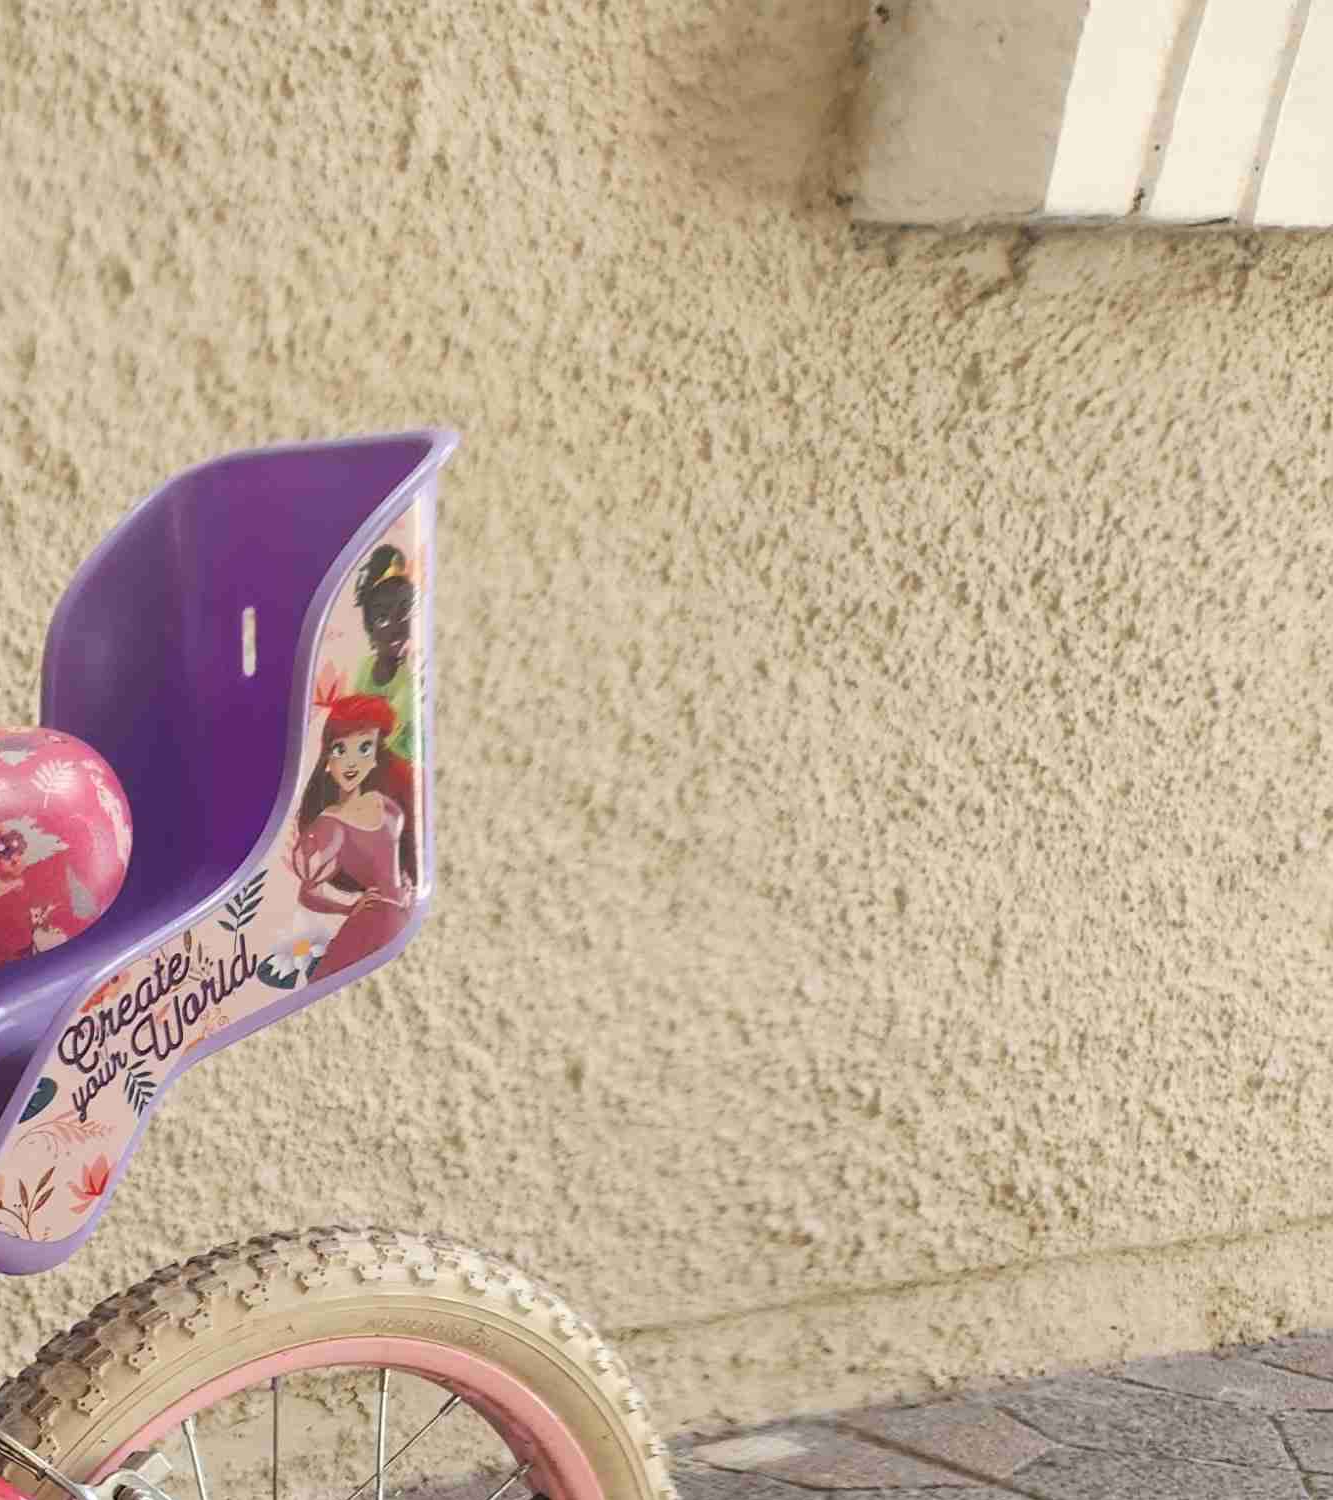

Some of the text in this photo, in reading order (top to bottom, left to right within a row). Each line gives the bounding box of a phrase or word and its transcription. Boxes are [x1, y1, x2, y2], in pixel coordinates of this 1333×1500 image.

[57, 951, 190, 1074] Create
[71, 932, 258, 1123] your World
